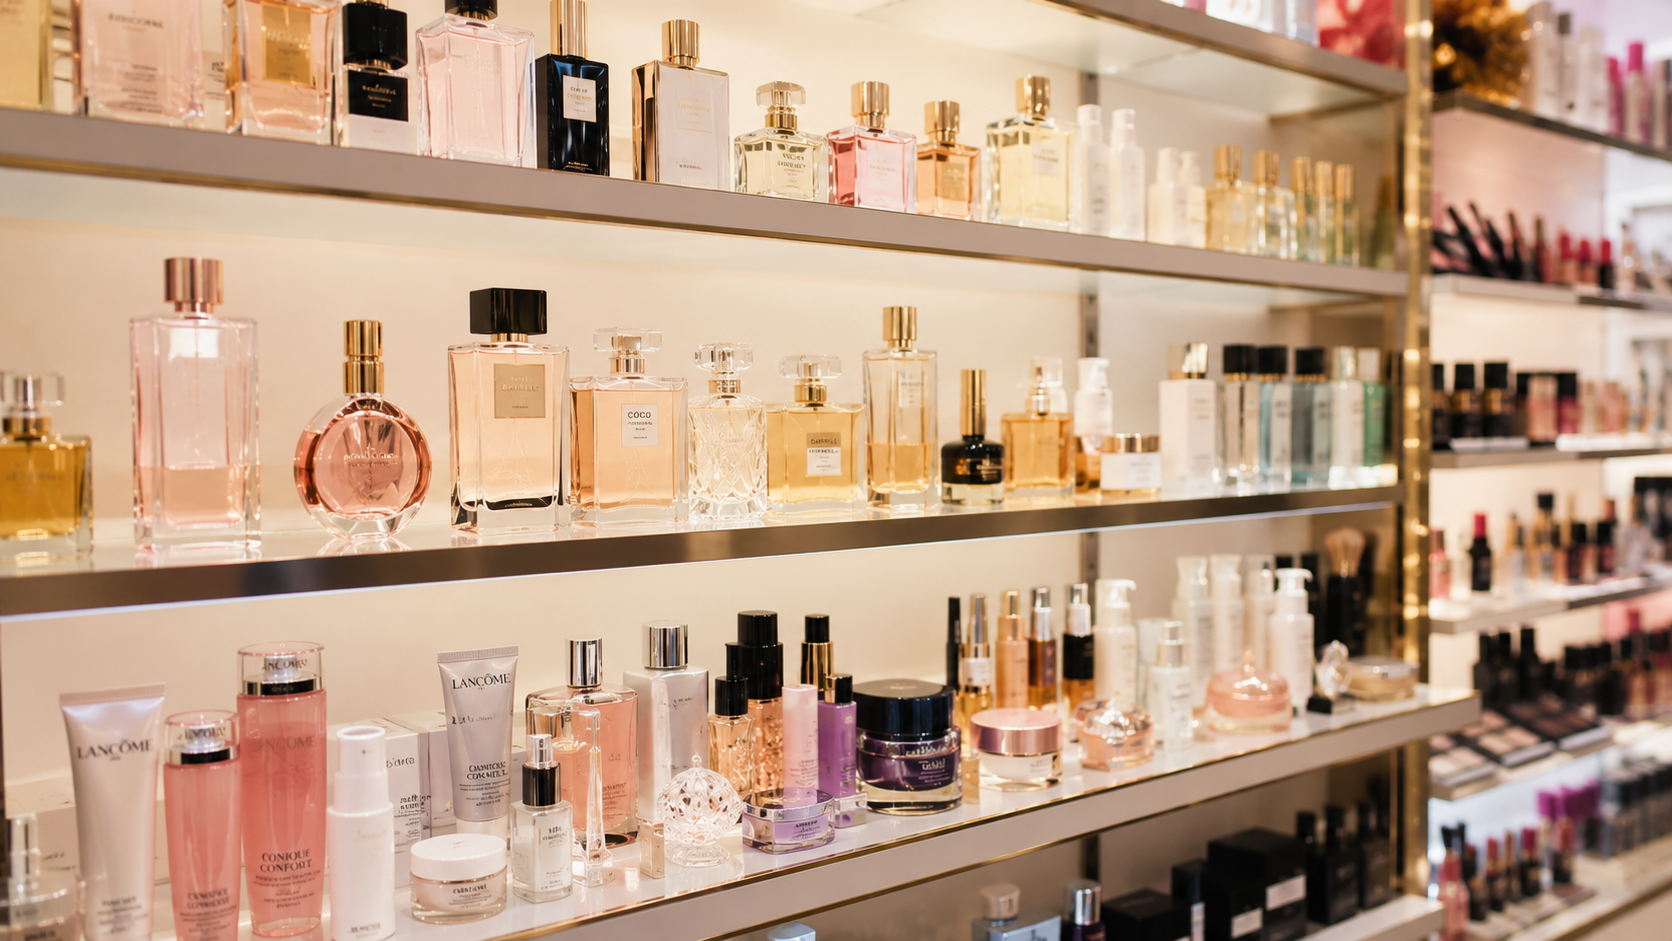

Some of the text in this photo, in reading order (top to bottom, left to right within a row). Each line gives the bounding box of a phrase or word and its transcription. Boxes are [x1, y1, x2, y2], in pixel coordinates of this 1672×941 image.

[626, 411, 652, 419] COCO
[451, 673, 511, 689] LANCÔME
[77, 738, 154, 759] LANCÔME
